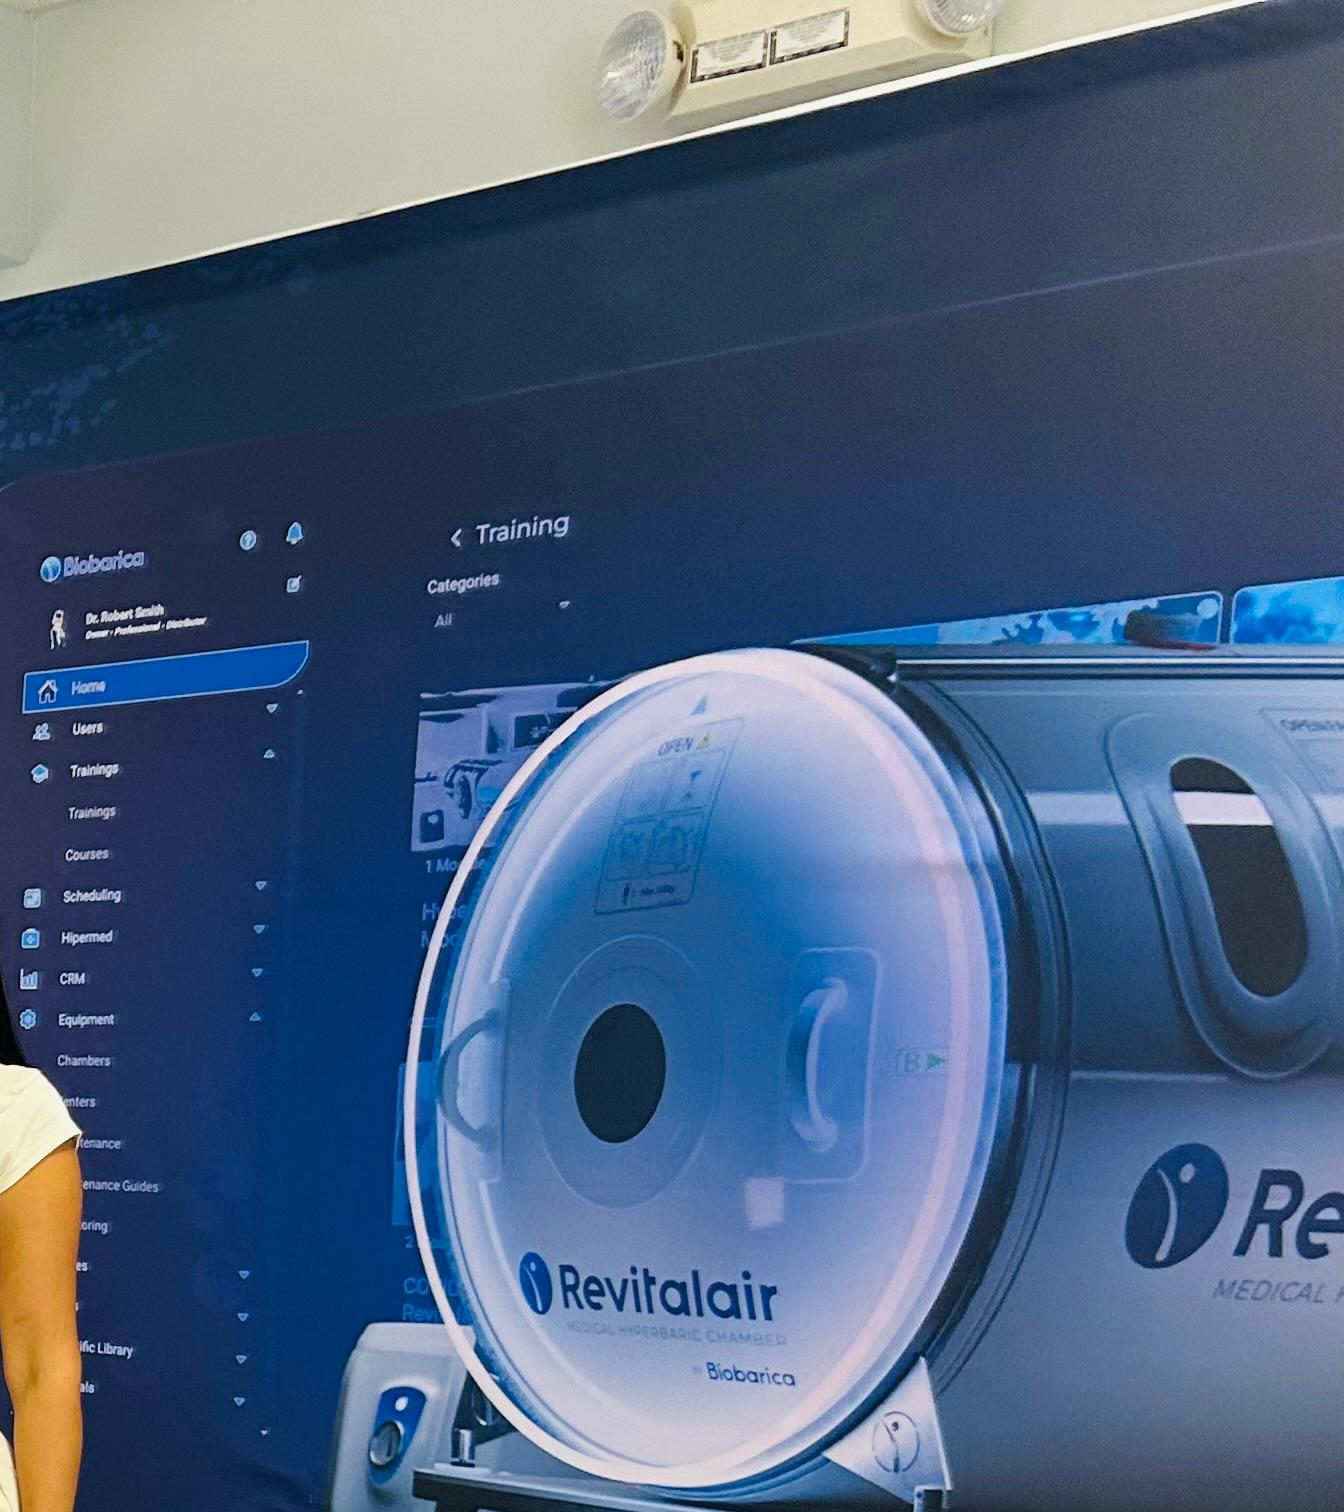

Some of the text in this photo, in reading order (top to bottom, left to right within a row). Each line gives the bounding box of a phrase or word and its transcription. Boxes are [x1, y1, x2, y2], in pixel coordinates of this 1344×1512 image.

[475, 515, 571, 545] Training
[63, 550, 144, 577] Biobarica
[427, 573, 500, 594] Categories
[86, 612, 100, 625] Dr.
[135, 603, 165, 619] Smith
[434, 612, 453, 628] All
[72, 681, 106, 695] Home
[73, 722, 104, 736] Users
[70, 763, 119, 777] Trainings
[68, 806, 116, 820] Trainings
[65, 849, 109, 862] Courses
[63, 888, 122, 904] Scheduling
[61, 930, 113, 946] Hipermed
[59, 972, 86, 985] CRM
[58, 1013, 115, 1028] Equipment
[57, 1054, 111, 1067] Chambers
[63, 1097, 96, 1108] enters
[79, 1138, 122, 1149] tenance
[82, 1180, 160, 1193] enance Guides
[559, 1264, 778, 1322] Revitalair
[1212, 1279, 1325, 1303] MEDICAL
[97, 1342, 134, 1360] Library
[706, 1361, 796, 1387] Biobarica
